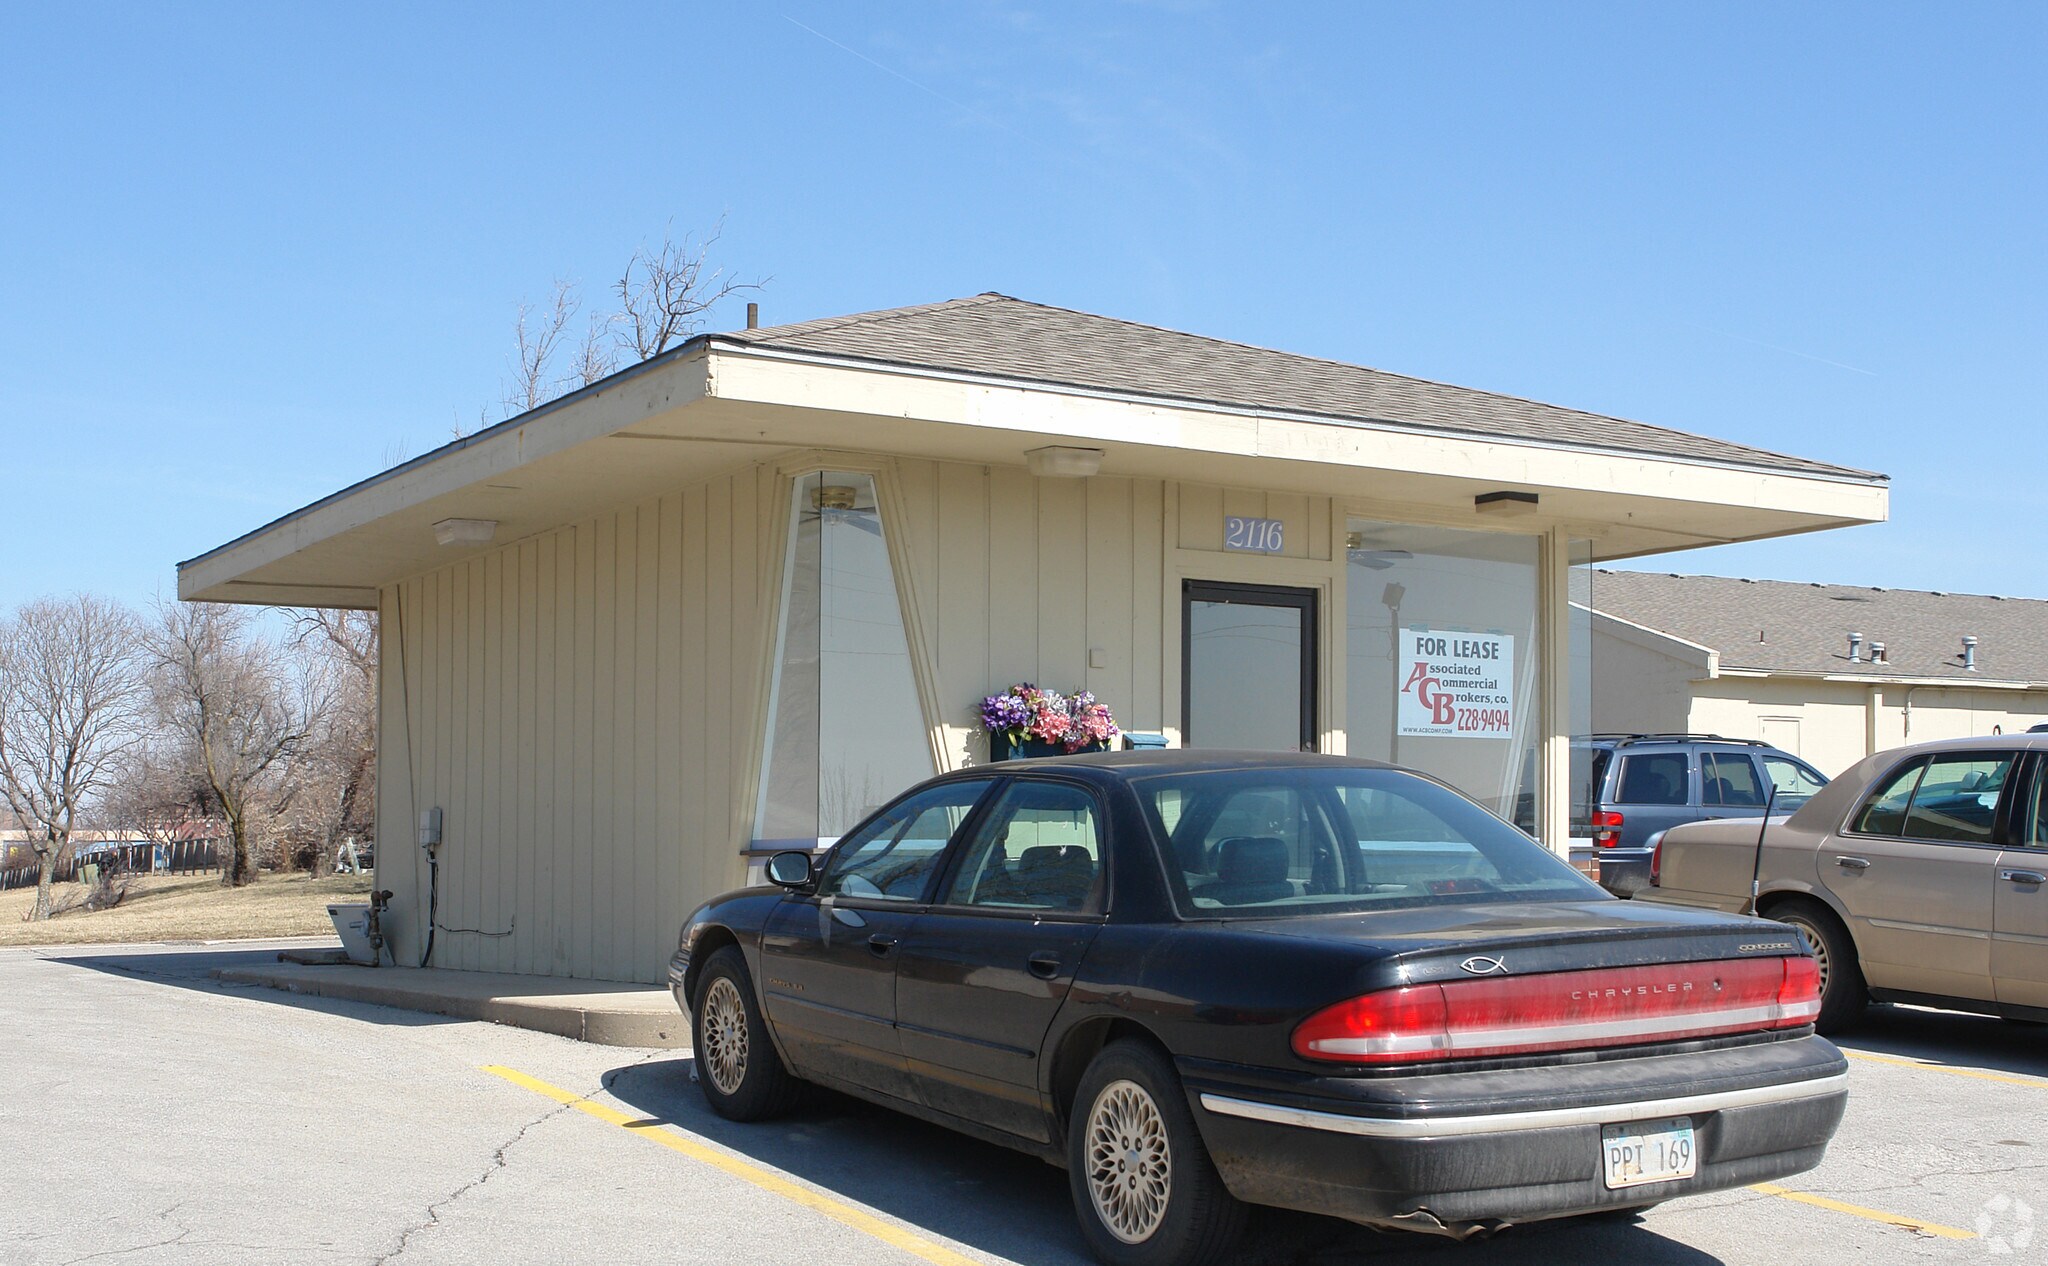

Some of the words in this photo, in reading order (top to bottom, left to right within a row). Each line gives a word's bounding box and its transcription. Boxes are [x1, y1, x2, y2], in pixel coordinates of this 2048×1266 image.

[1226, 518, 1283, 551] 2116
[1416, 637, 1447, 656] FOR
[1453, 640, 1499, 660] LEASE
[1401, 662, 1481, 692] Associated
[1418, 677, 1498, 709] Commercial
[1571, 982, 1693, 1000] CHRYSLER
[1611, 1144, 1643, 1178] PPI
[1658, 1138, 1690, 1172] 169
